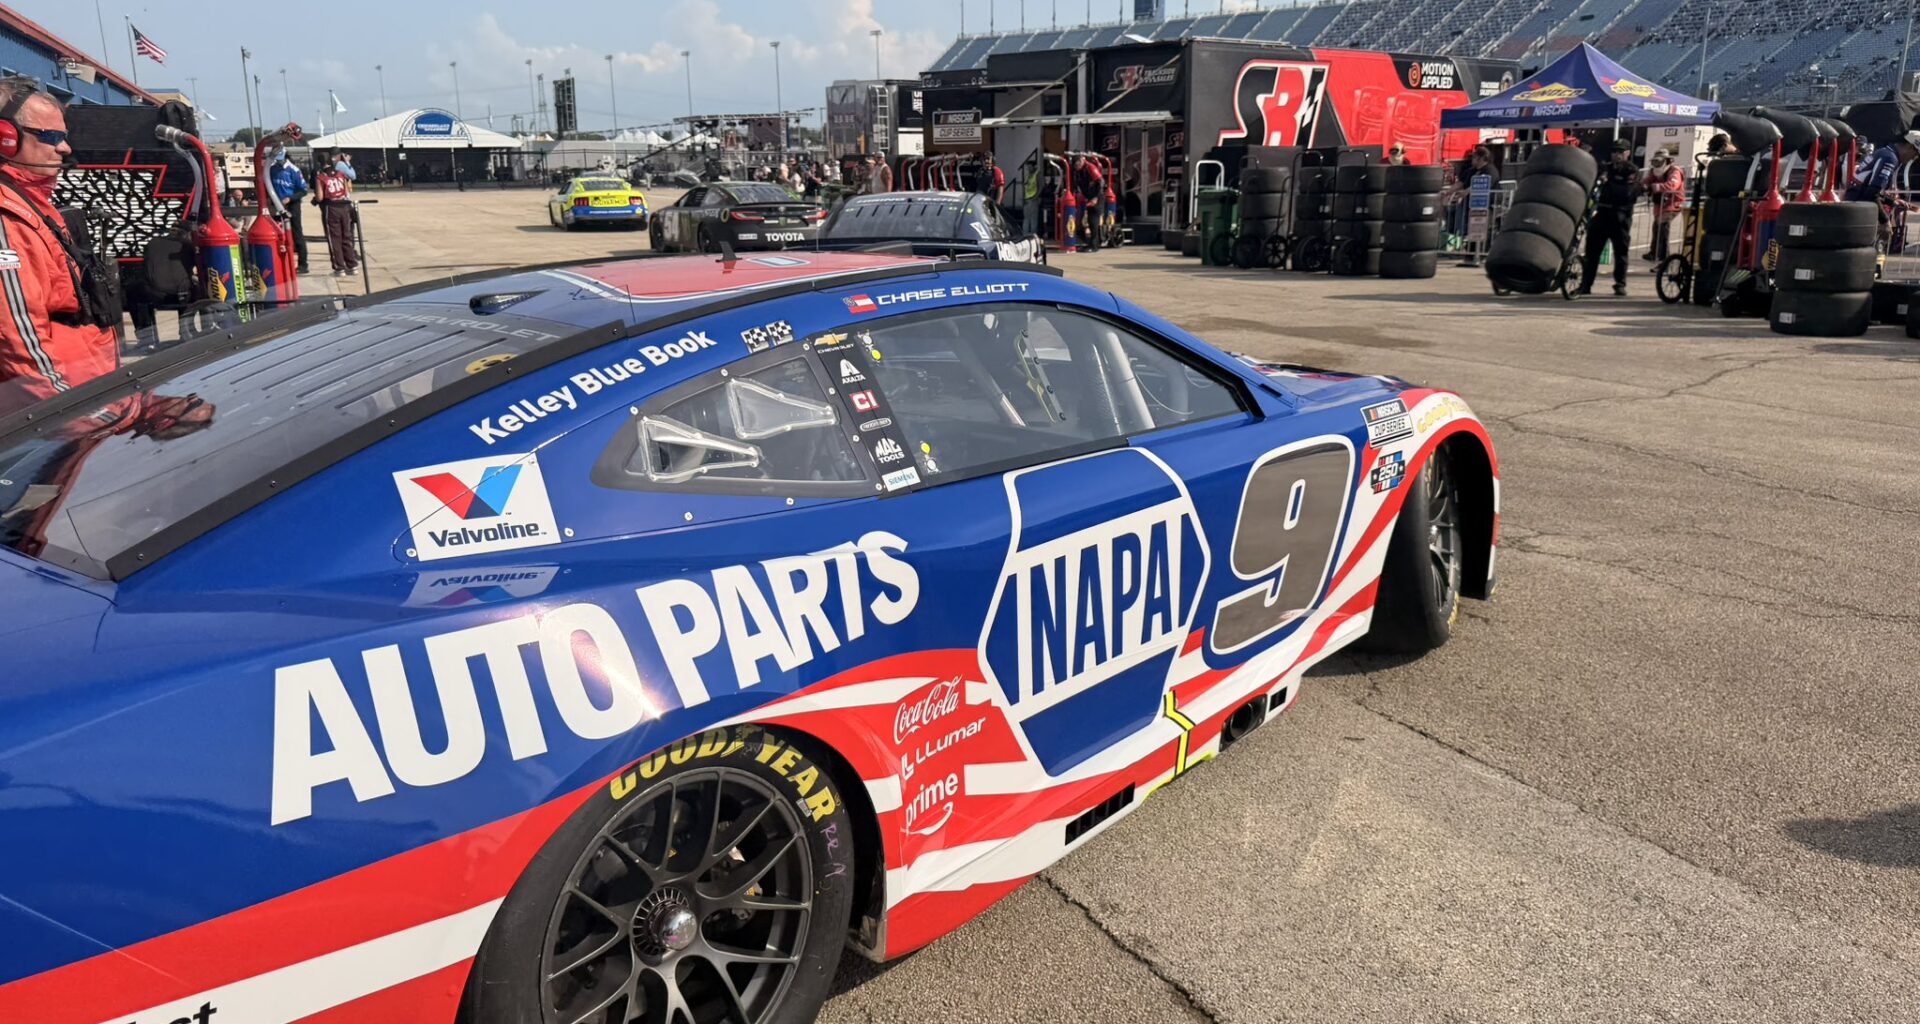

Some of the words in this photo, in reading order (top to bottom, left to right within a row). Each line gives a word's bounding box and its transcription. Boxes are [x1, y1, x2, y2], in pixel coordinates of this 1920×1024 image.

[1421, 62, 1454, 76] MOTION
[1421, 76, 1453, 89] APPLIED
[1516, 87, 1584, 100] SUNOCO
[1532, 104, 1573, 117] NASCAR
[953, 128, 975, 137] SERIES
[765, 232, 805, 242] TOYOTA
[876, 288, 946, 305] CHASE
[951, 283, 1030, 296] ELLIOTT
[382, 313, 561, 341] CHEVROLET
[468, 384, 579, 445] Kelley
[569, 356, 646, 396] Blue
[638, 330, 718, 367] Book
[842, 374, 867, 385] AXALTA
[1387, 418, 1406, 433] SERIES
[875, 437, 903, 458] MAC
[878, 453, 905, 464] TOOLS
[887, 473, 915, 486] SIEMENS
[1380, 463, 1398, 481] 250
[428, 520, 540, 549] Valvoline
[1210, 434, 1356, 656] 9
[1030, 522, 1173, 696] NAPA
[271, 602, 646, 826] AUTO
[635, 530, 920, 709] PARTS
[905, 772, 959, 837] prime
